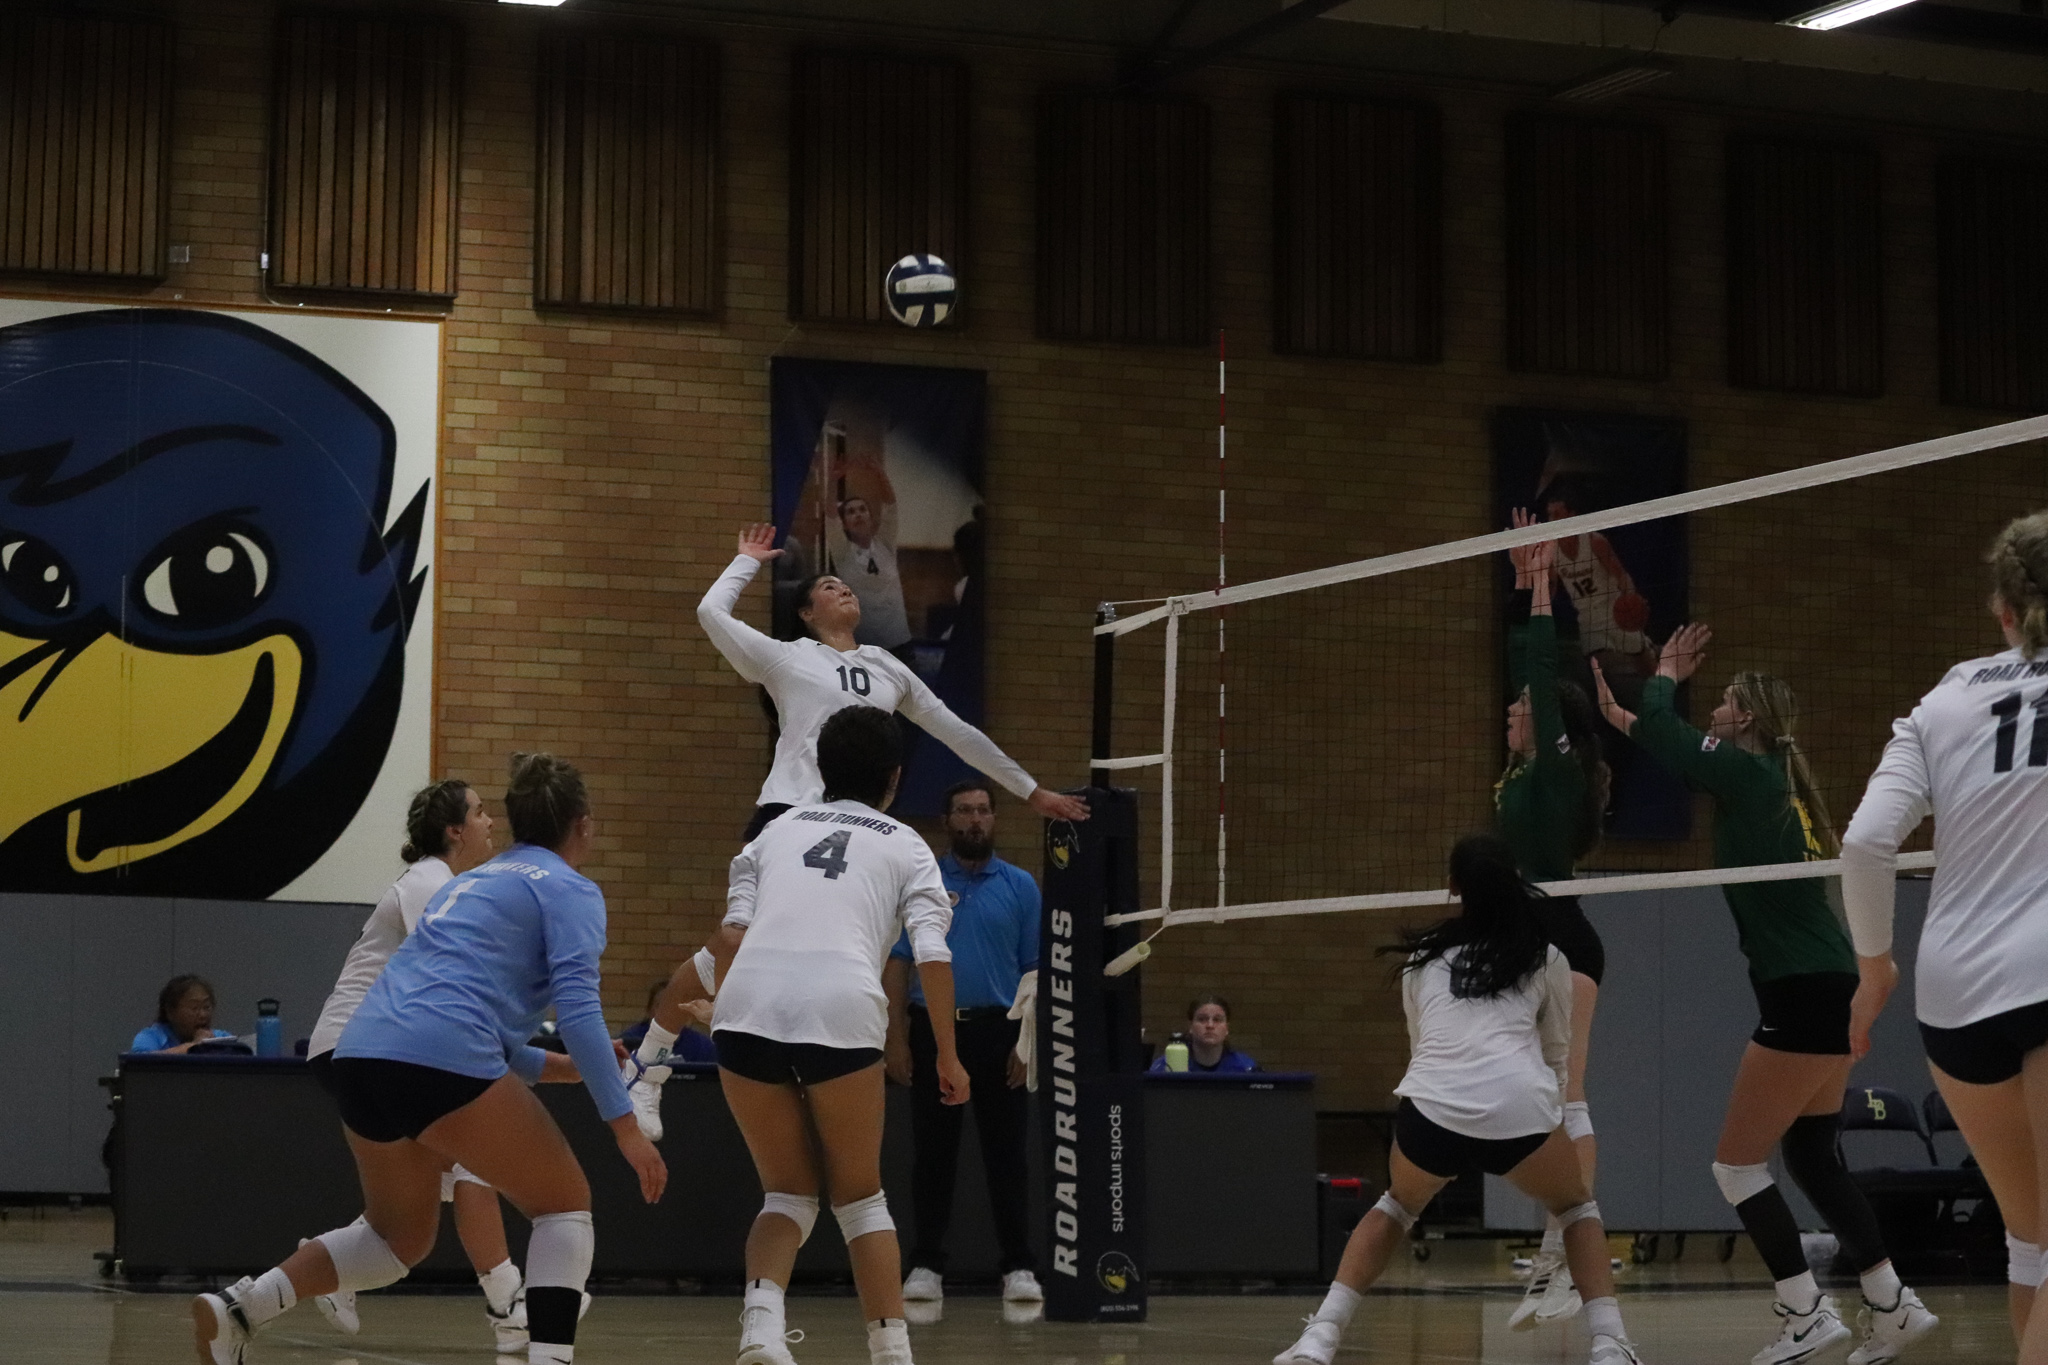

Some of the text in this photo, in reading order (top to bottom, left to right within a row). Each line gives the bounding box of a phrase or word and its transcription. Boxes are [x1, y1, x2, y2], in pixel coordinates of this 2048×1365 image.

[866, 557, 880, 576] 4
[1573, 578, 1597, 597] 12
[836, 664, 871, 697] 10
[1967, 662, 2026, 687] ROAD
[792, 811, 898, 836] ROAD RUNNERS
[802, 829, 853, 880] 4
[1051, 908, 1078, 1278] ROADRUNNERS
[1864, 1089, 1887, 1121] LB
[1108, 1104, 1126, 1233] sports imports
